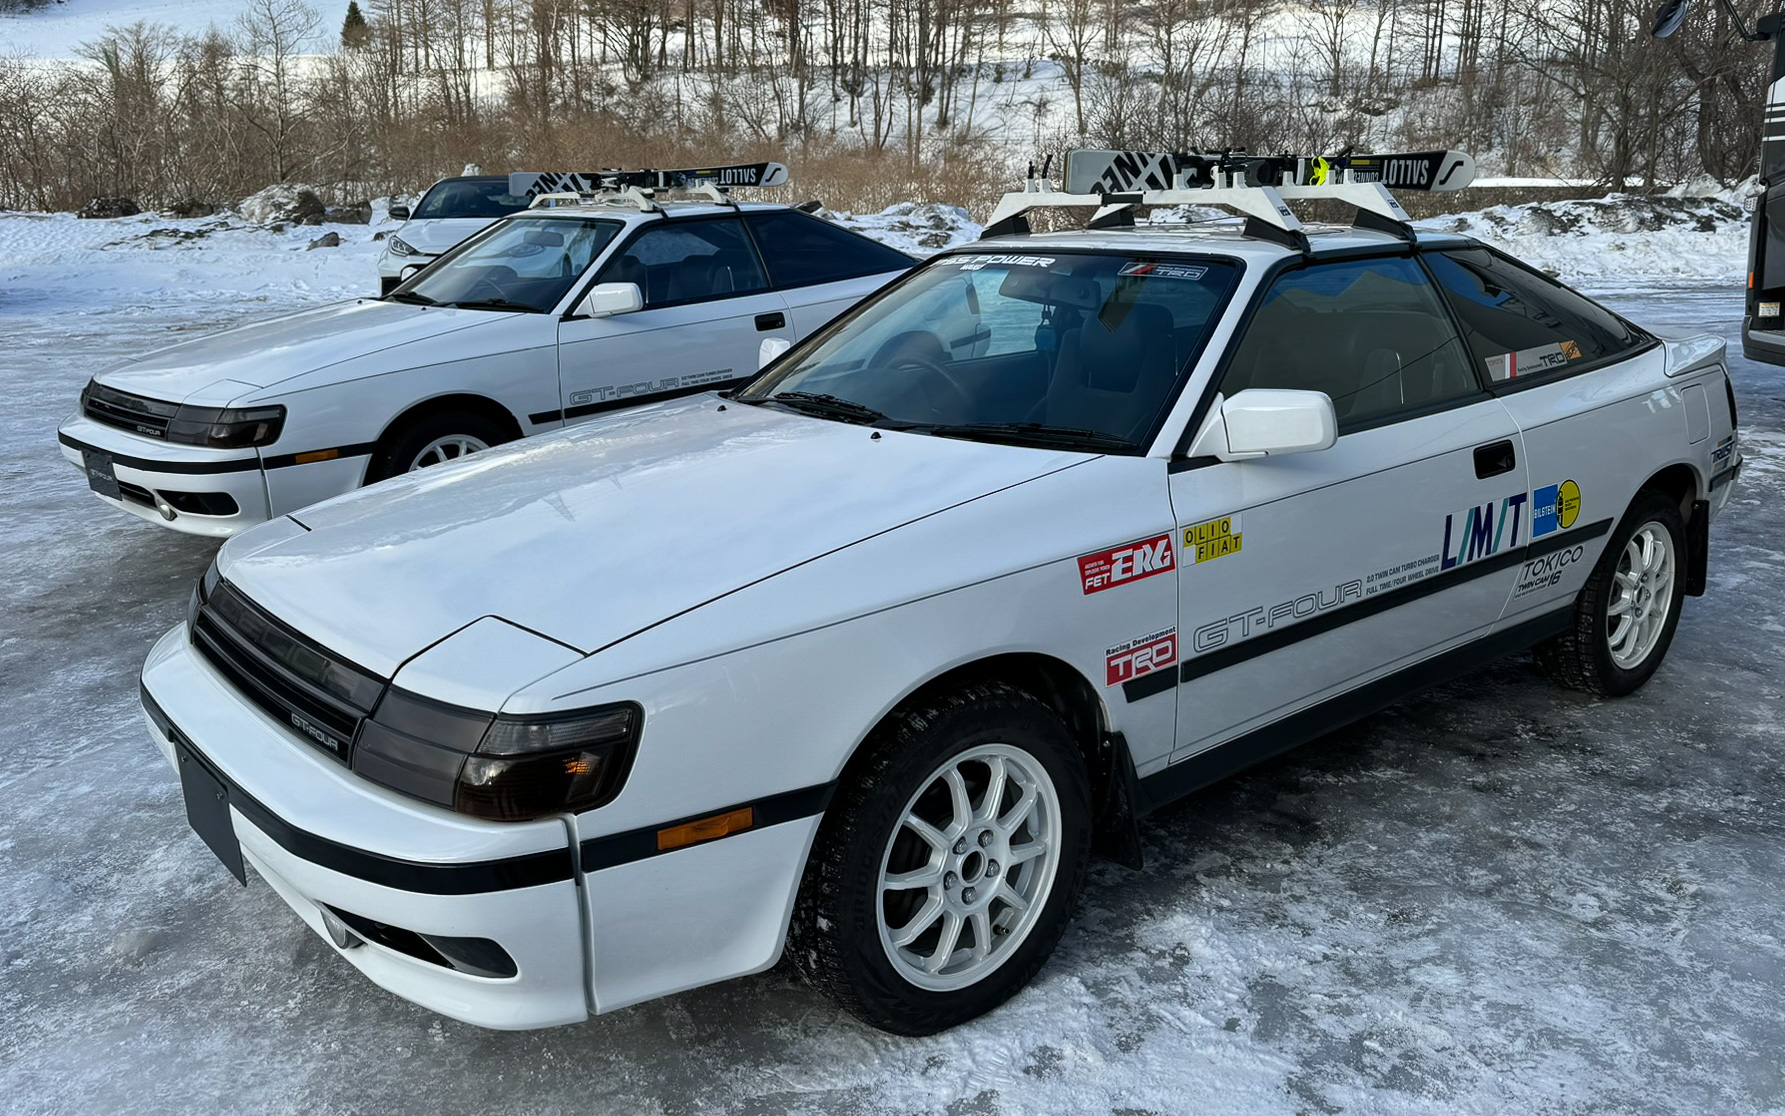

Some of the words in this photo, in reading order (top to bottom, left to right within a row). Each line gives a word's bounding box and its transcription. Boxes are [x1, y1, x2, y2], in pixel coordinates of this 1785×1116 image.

[719, 168, 757, 185] SALLOT
[1382, 159, 1429, 185] SALLOT
[971, 255, 1056, 268] POWER
[1156, 269, 1201, 278] TRD
[1539, 352, 1566, 368] TRD
[570, 377, 680, 405] GT-FOUR
[1534, 503, 1556, 519] BILSTEIN
[1185, 520, 1230, 544] OLIO
[1440, 491, 1528, 571] LIMIT
[1198, 536, 1240, 560] FIAT
[1085, 572, 1110, 590] FET
[1110, 538, 1172, 583] ERG
[1375, 570, 1389, 580] TWIN
[1388, 565, 1401, 576] CAM
[1401, 560, 1418, 572] TURBO
[1417, 554, 1440, 567] CHARGER
[1524, 545, 1584, 581] TOKICO
[1366, 585, 1378, 596] FULL
[1407, 570, 1424, 582] WHEEL
[1424, 565, 1439, 577] DRIVE
[1192, 578, 1363, 653] GT-FOUR
[1105, 642, 1131, 656] Racing
[1132, 626, 1176, 646] Development
[1110, 640, 1173, 677] TRD
[290, 713, 339, 751] GT-FOUR
